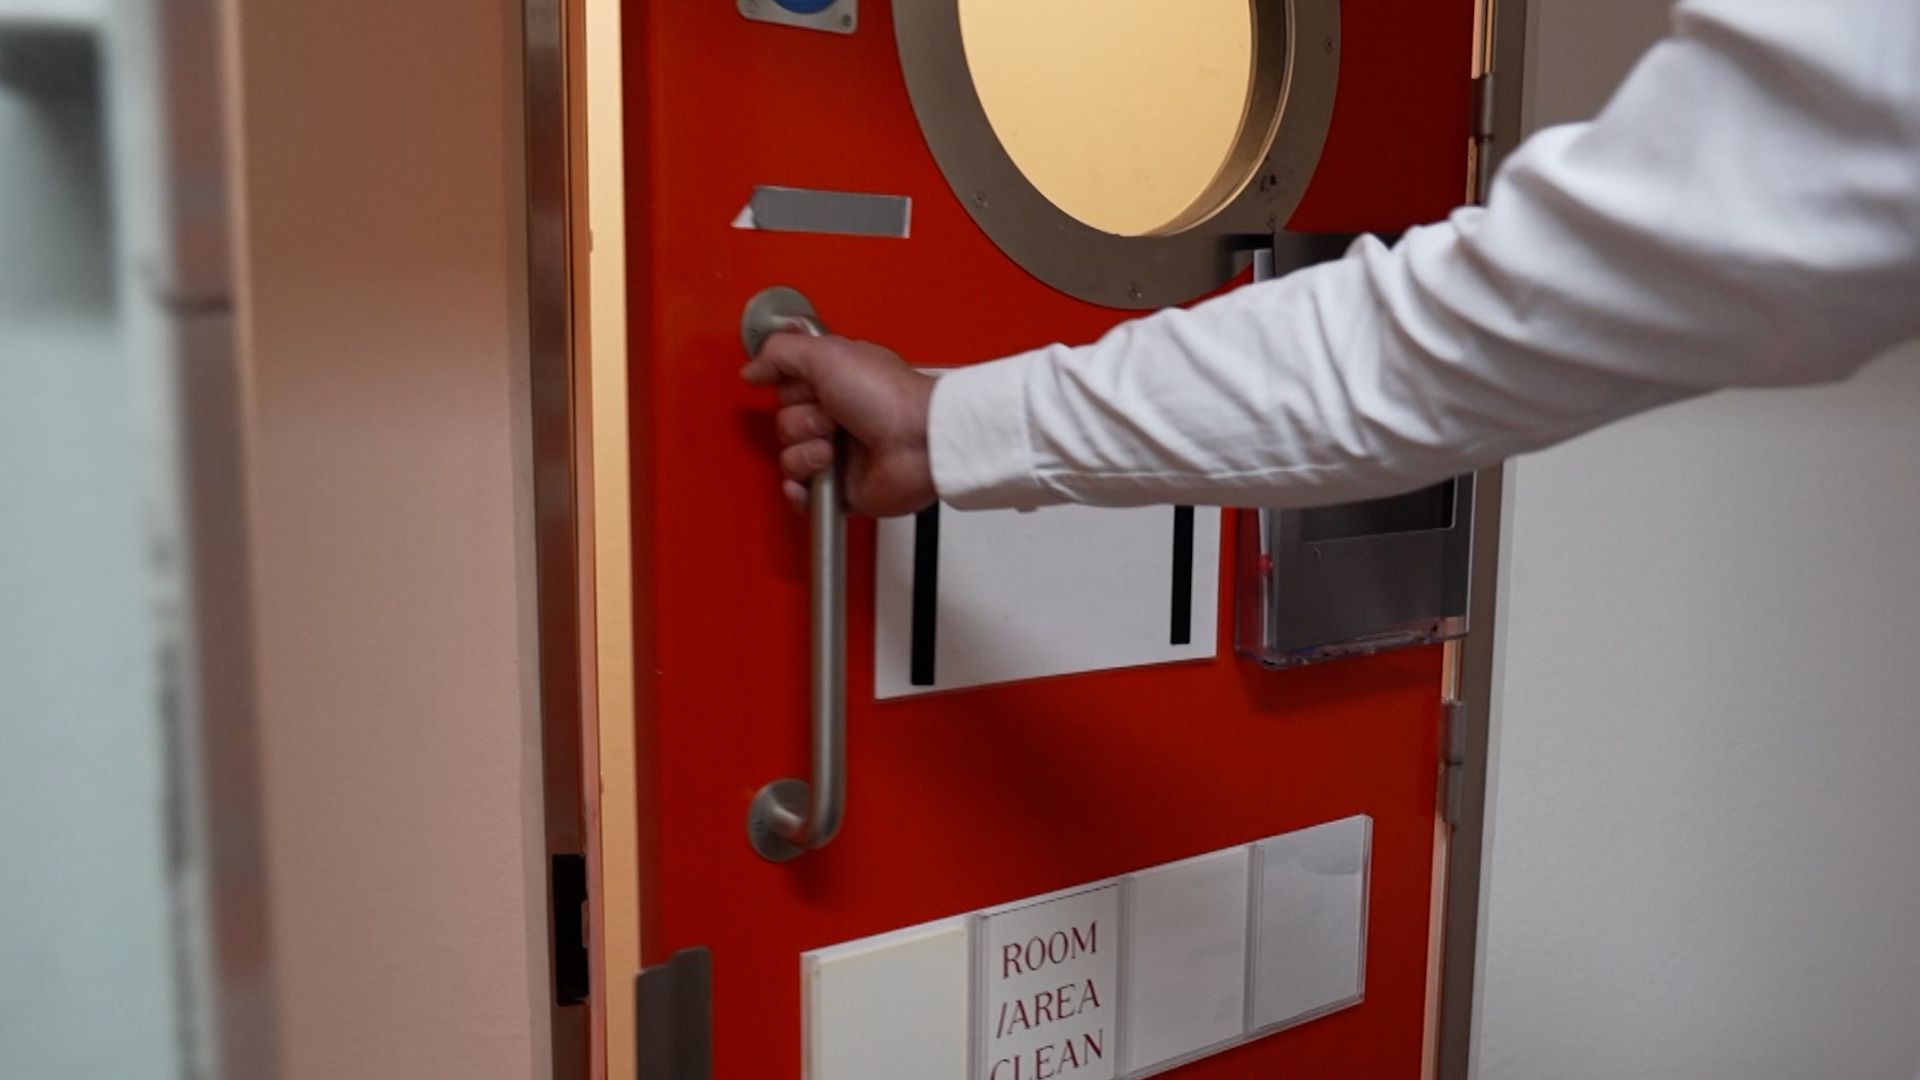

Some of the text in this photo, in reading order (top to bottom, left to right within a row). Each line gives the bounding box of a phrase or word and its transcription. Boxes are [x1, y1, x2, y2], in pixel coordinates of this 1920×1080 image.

[1002, 921, 1097, 979] ROOM
[997, 979, 1101, 1039] /AREA
[989, 1029, 1104, 1080] CLEAN
